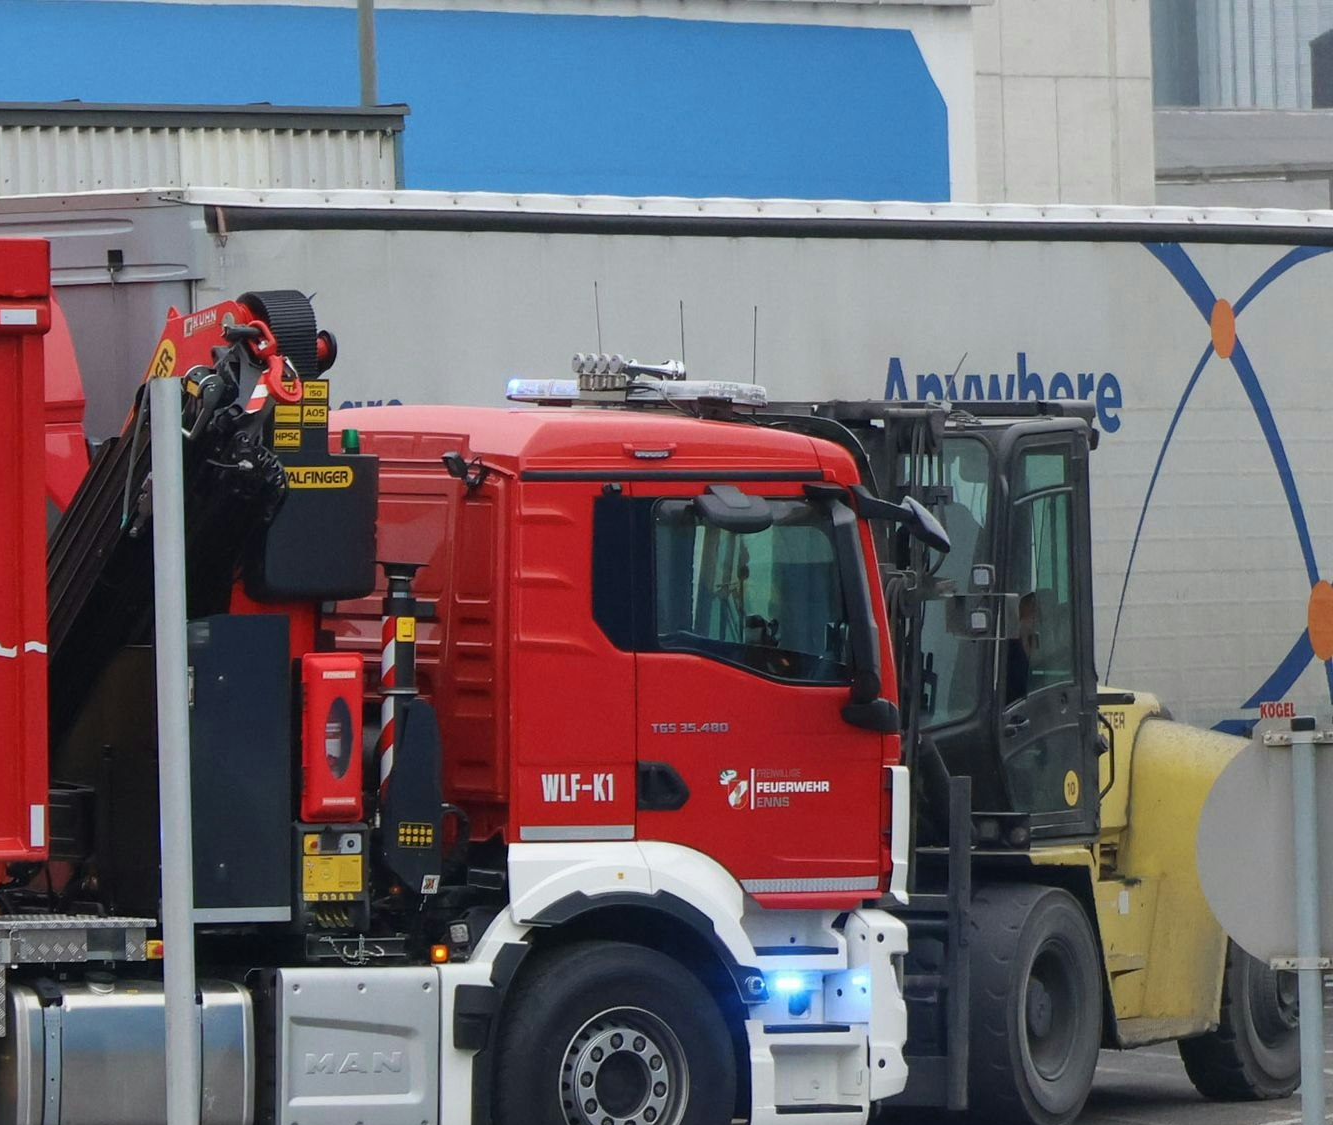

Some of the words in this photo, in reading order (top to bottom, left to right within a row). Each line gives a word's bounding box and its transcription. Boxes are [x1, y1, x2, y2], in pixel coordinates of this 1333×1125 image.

[285, 470, 349, 485] ALFINGER
[1260, 702, 1297, 719] KÖGEL
[651, 722, 677, 733] TGS
[680, 722, 729, 733] 35.480
[541, 773, 614, 802] WLF-K1
[756, 781, 830, 794] FEUERWEHR
[756, 796, 790, 808] ENNS
[305, 1052, 402, 1075] MAN
